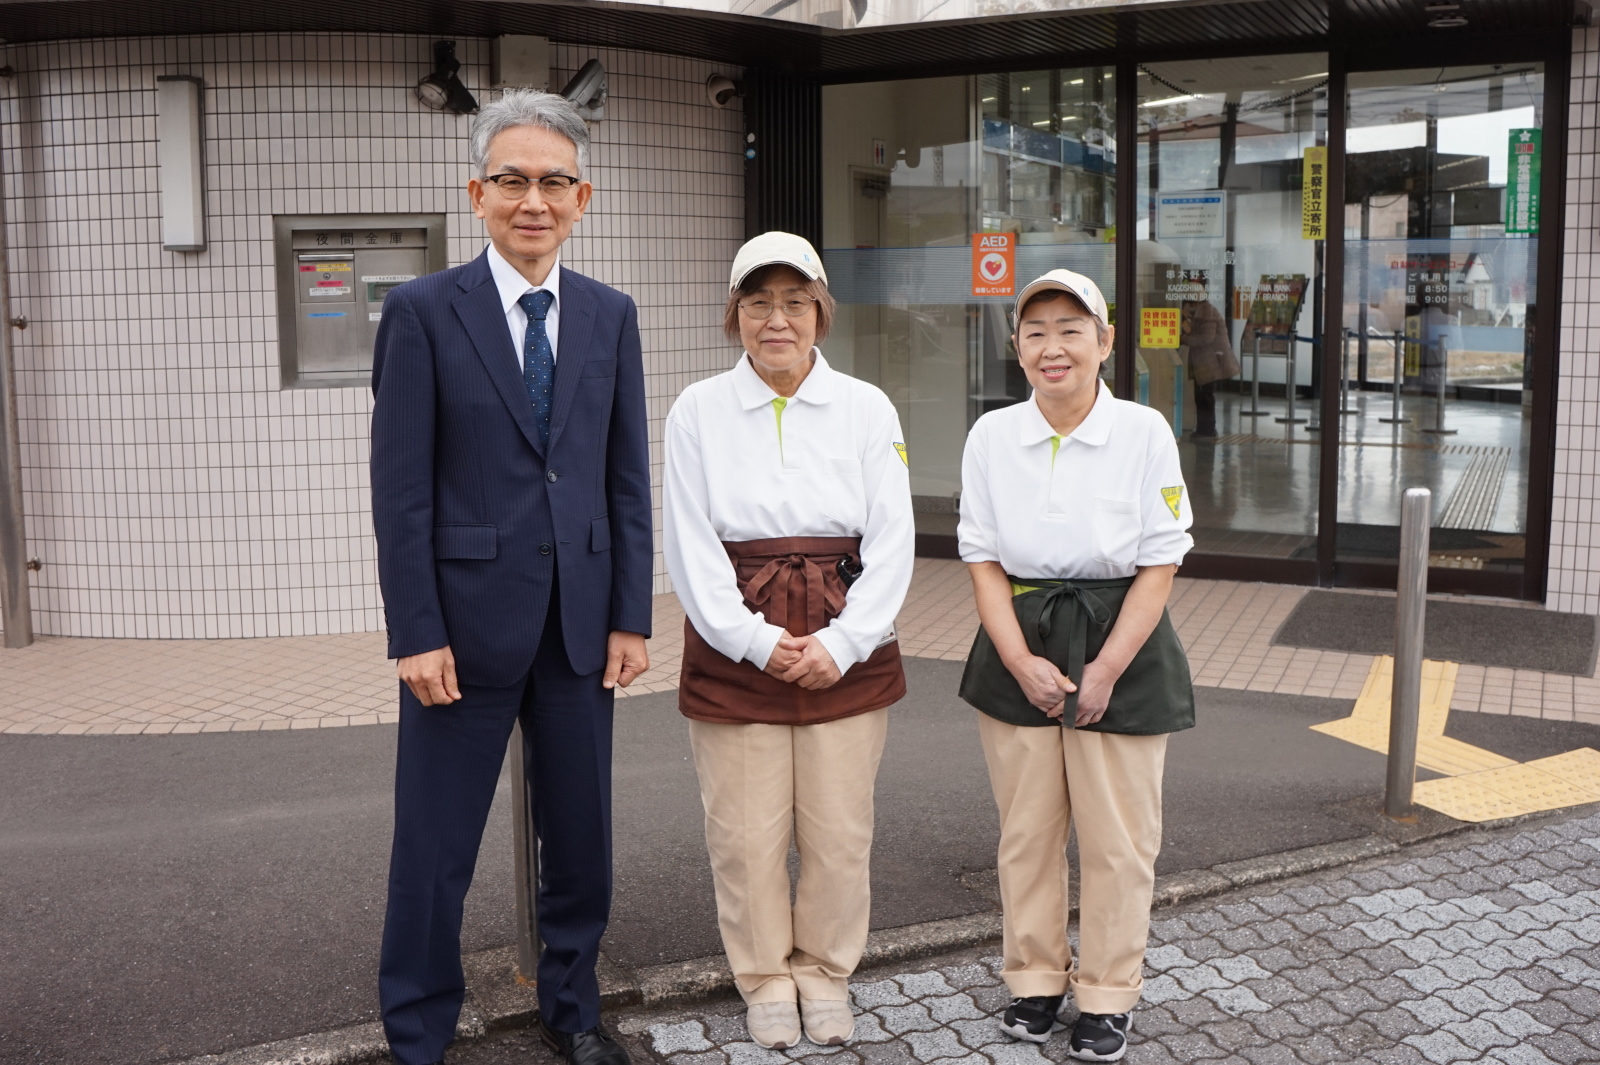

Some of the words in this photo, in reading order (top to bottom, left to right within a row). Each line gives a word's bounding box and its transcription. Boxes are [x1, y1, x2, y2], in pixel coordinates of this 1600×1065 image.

[1310, 164, 1322, 236] 警察官立寄所
[316, 232, 403, 246] 夜間金庫
[980, 236, 1008, 247] AED
[1165, 270, 1224, 280] 串木野支店
[1167, 284, 1203, 292] KAGOSHIMA
[1205, 284, 1220, 292] BANK
[1273, 284, 1291, 292] BANK
[1165, 293, 1198, 301] KUSHIKINO
[1200, 293, 1223, 301] BRANCH
[1240, 293, 1260, 301] ICHIKI
[1262, 293, 1288, 301] BRANCH
[1143, 311, 1177, 319] 投資信託
[1143, 320, 1177, 328] 外貨預金
